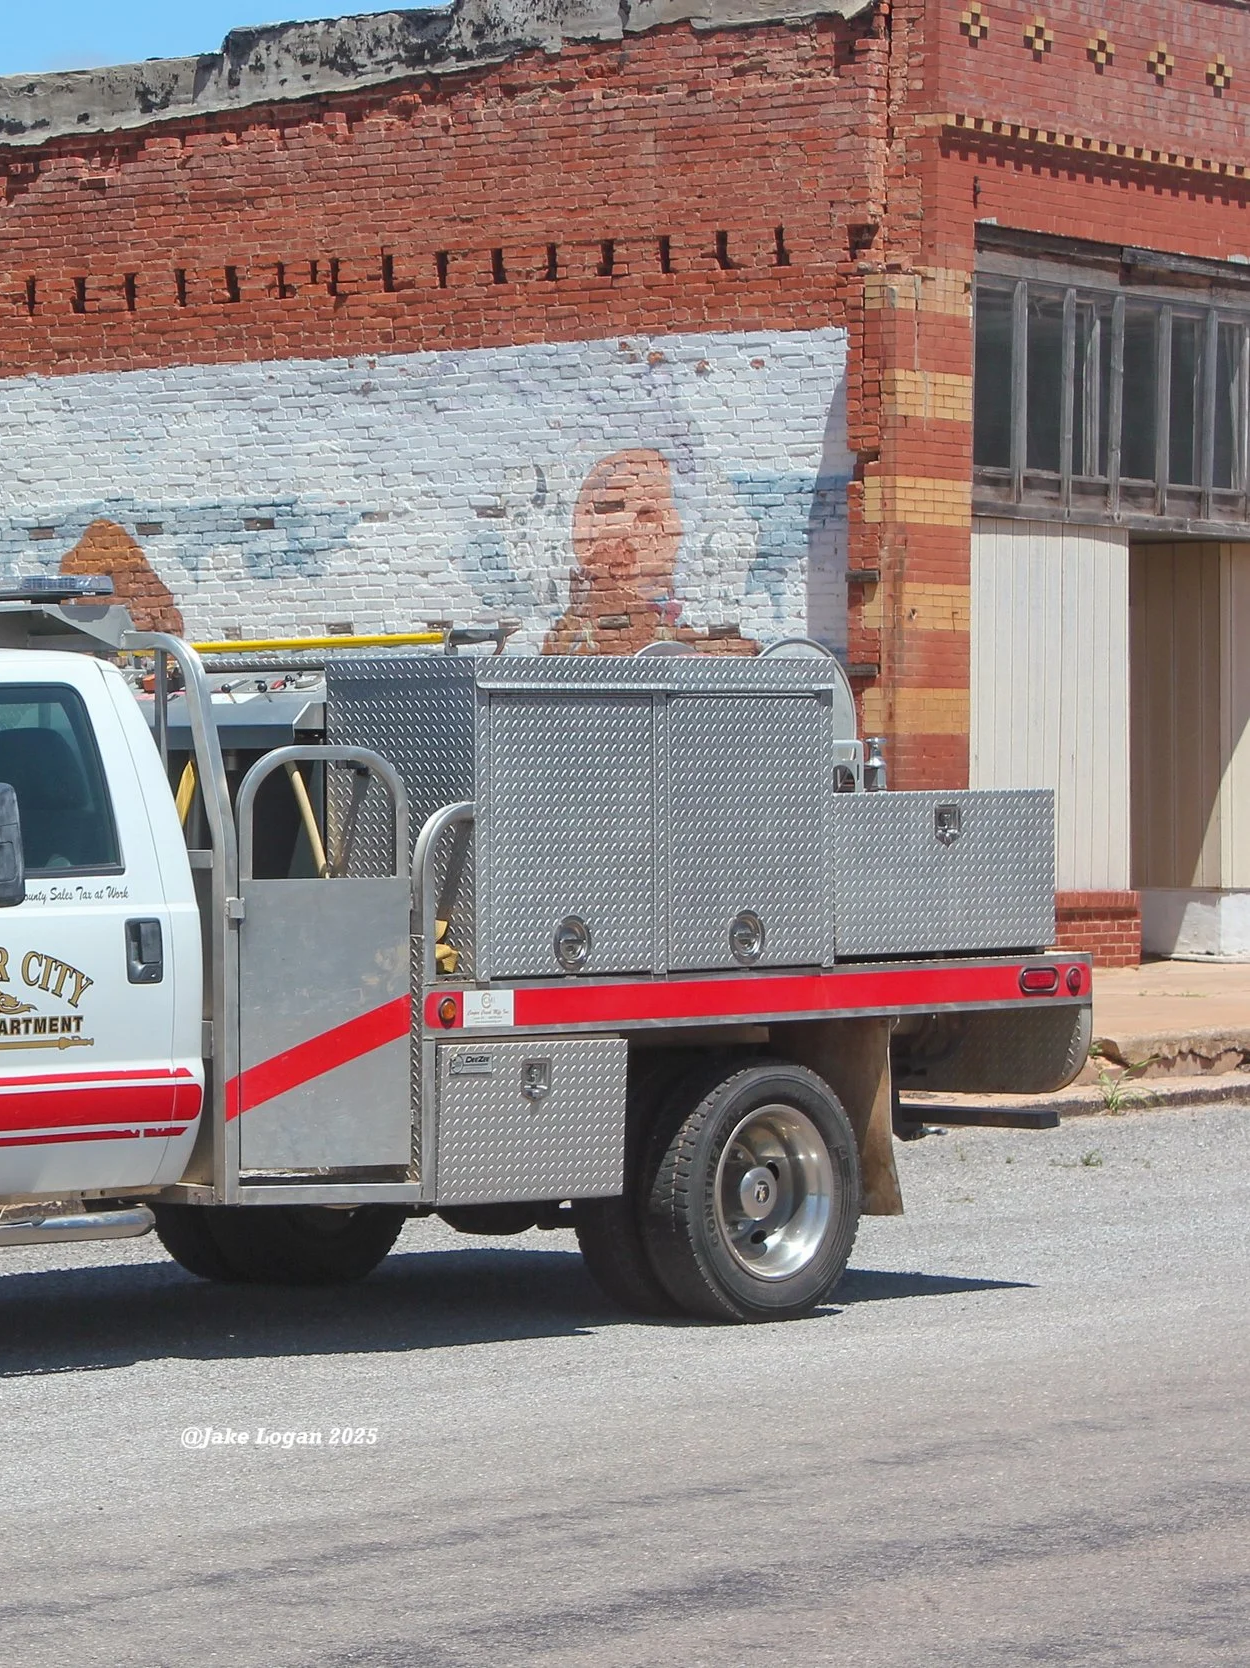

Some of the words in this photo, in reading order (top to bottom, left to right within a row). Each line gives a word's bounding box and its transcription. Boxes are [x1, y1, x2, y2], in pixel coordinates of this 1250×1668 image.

[24, 891, 46, 905] ounty
[50, 887, 73, 901] Sales
[75, 886, 92, 900] Tax
[94, 890, 104, 899] at
[106, 886, 129, 899] Work
[21, 951, 94, 1008] CITY
